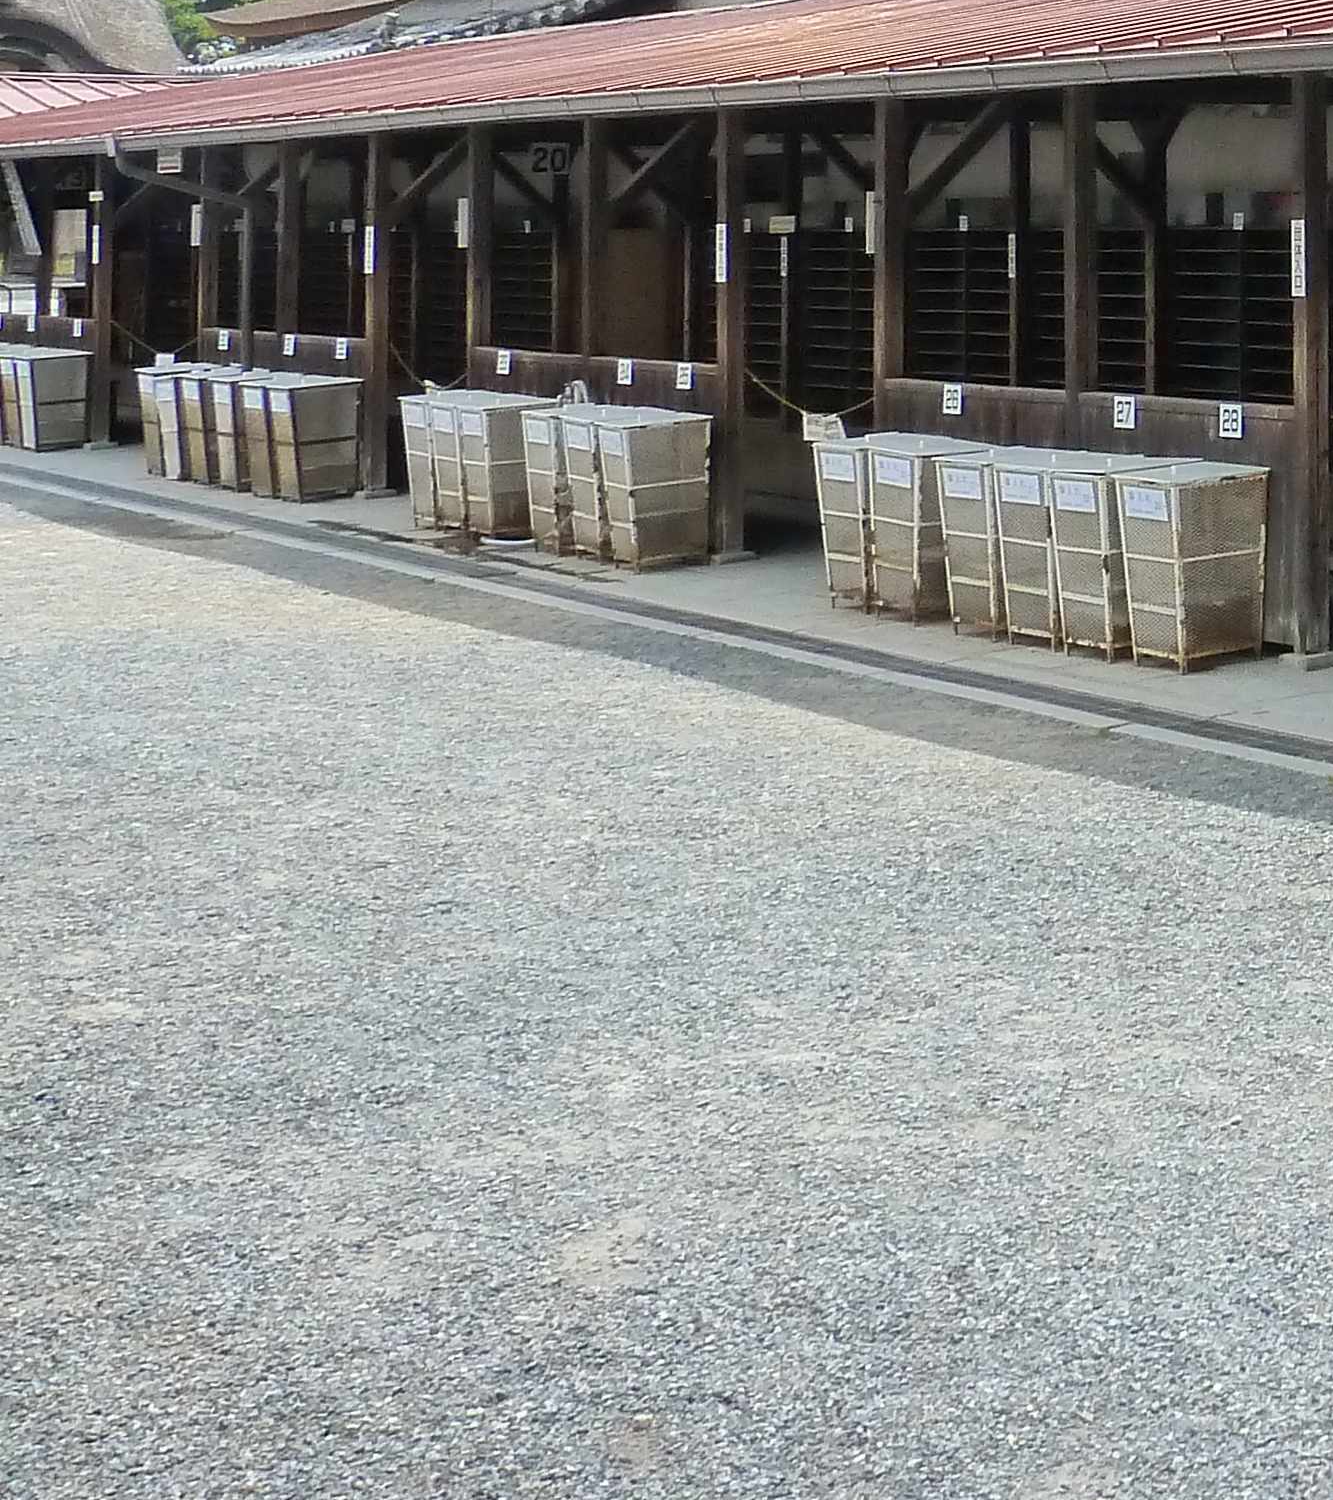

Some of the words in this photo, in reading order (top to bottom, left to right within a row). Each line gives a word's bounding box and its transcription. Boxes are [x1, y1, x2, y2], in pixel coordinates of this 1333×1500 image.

[532, 147, 567, 173] 20
[1117, 401, 1132, 424] 27
[1223, 409, 1239, 432] 28
